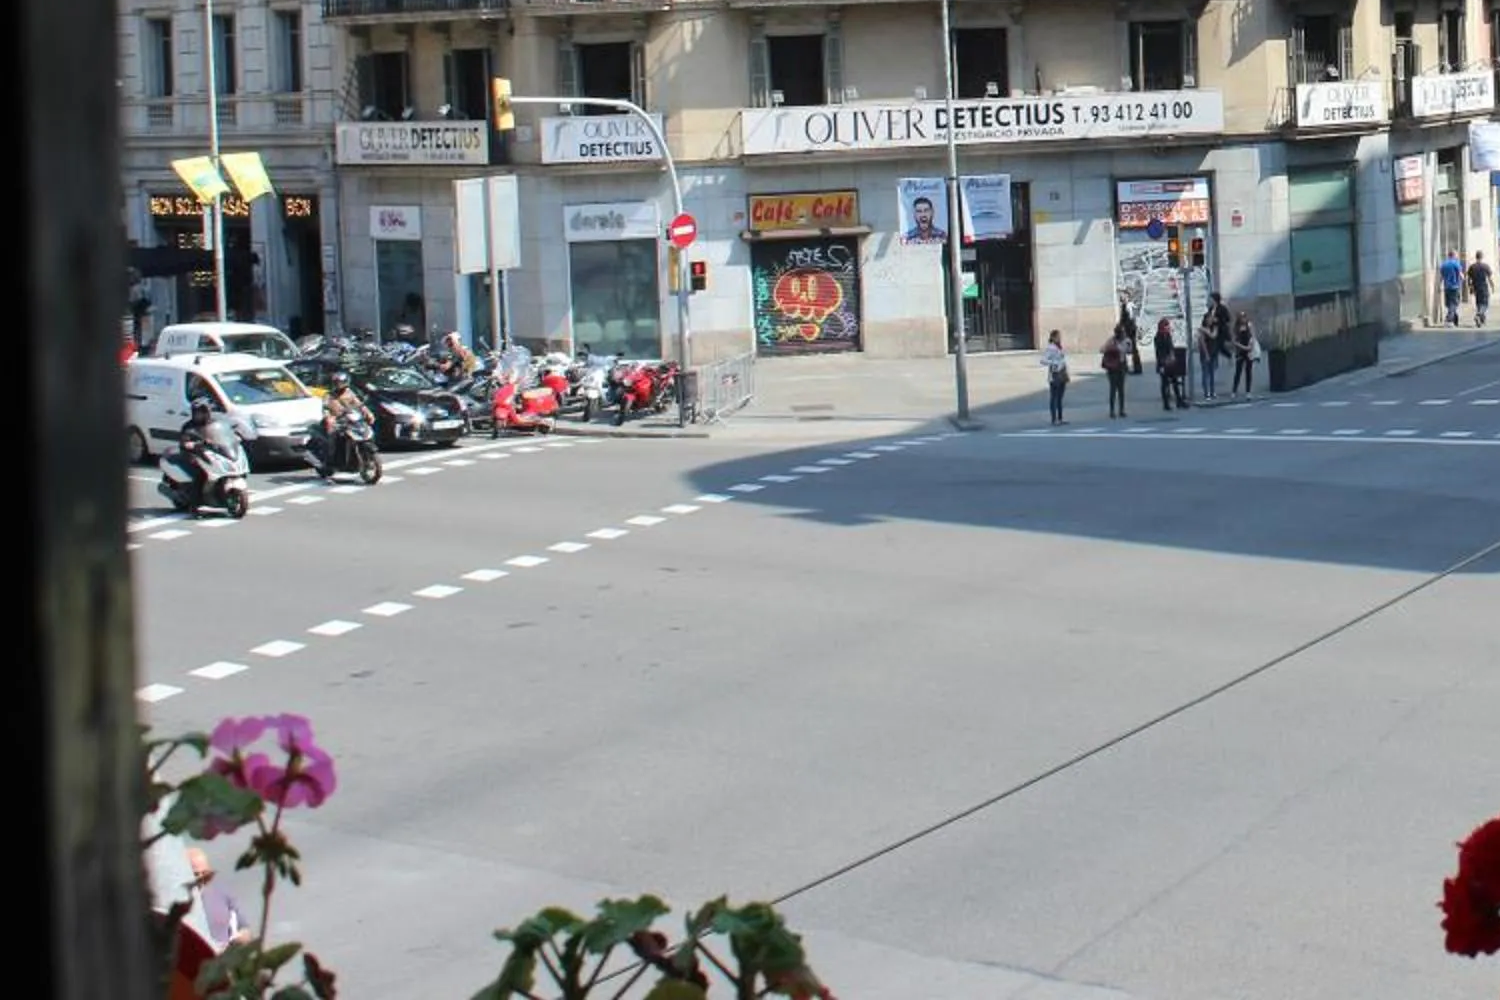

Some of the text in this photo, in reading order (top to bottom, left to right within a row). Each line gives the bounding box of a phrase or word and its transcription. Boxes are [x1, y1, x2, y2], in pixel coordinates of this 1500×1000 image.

[805, 99, 1195, 146] OLIVER DETECTIUS T. 93 412 41 00
[1323, 103, 1376, 121] DETECTIUS
[411, 125, 482, 150] DETECTIUS
[934, 127, 1066, 141] INESTIGACIÓ PRIVADA
[579, 141, 654, 158] DETECTIUS
[753, 199, 852, 223] Café Café
